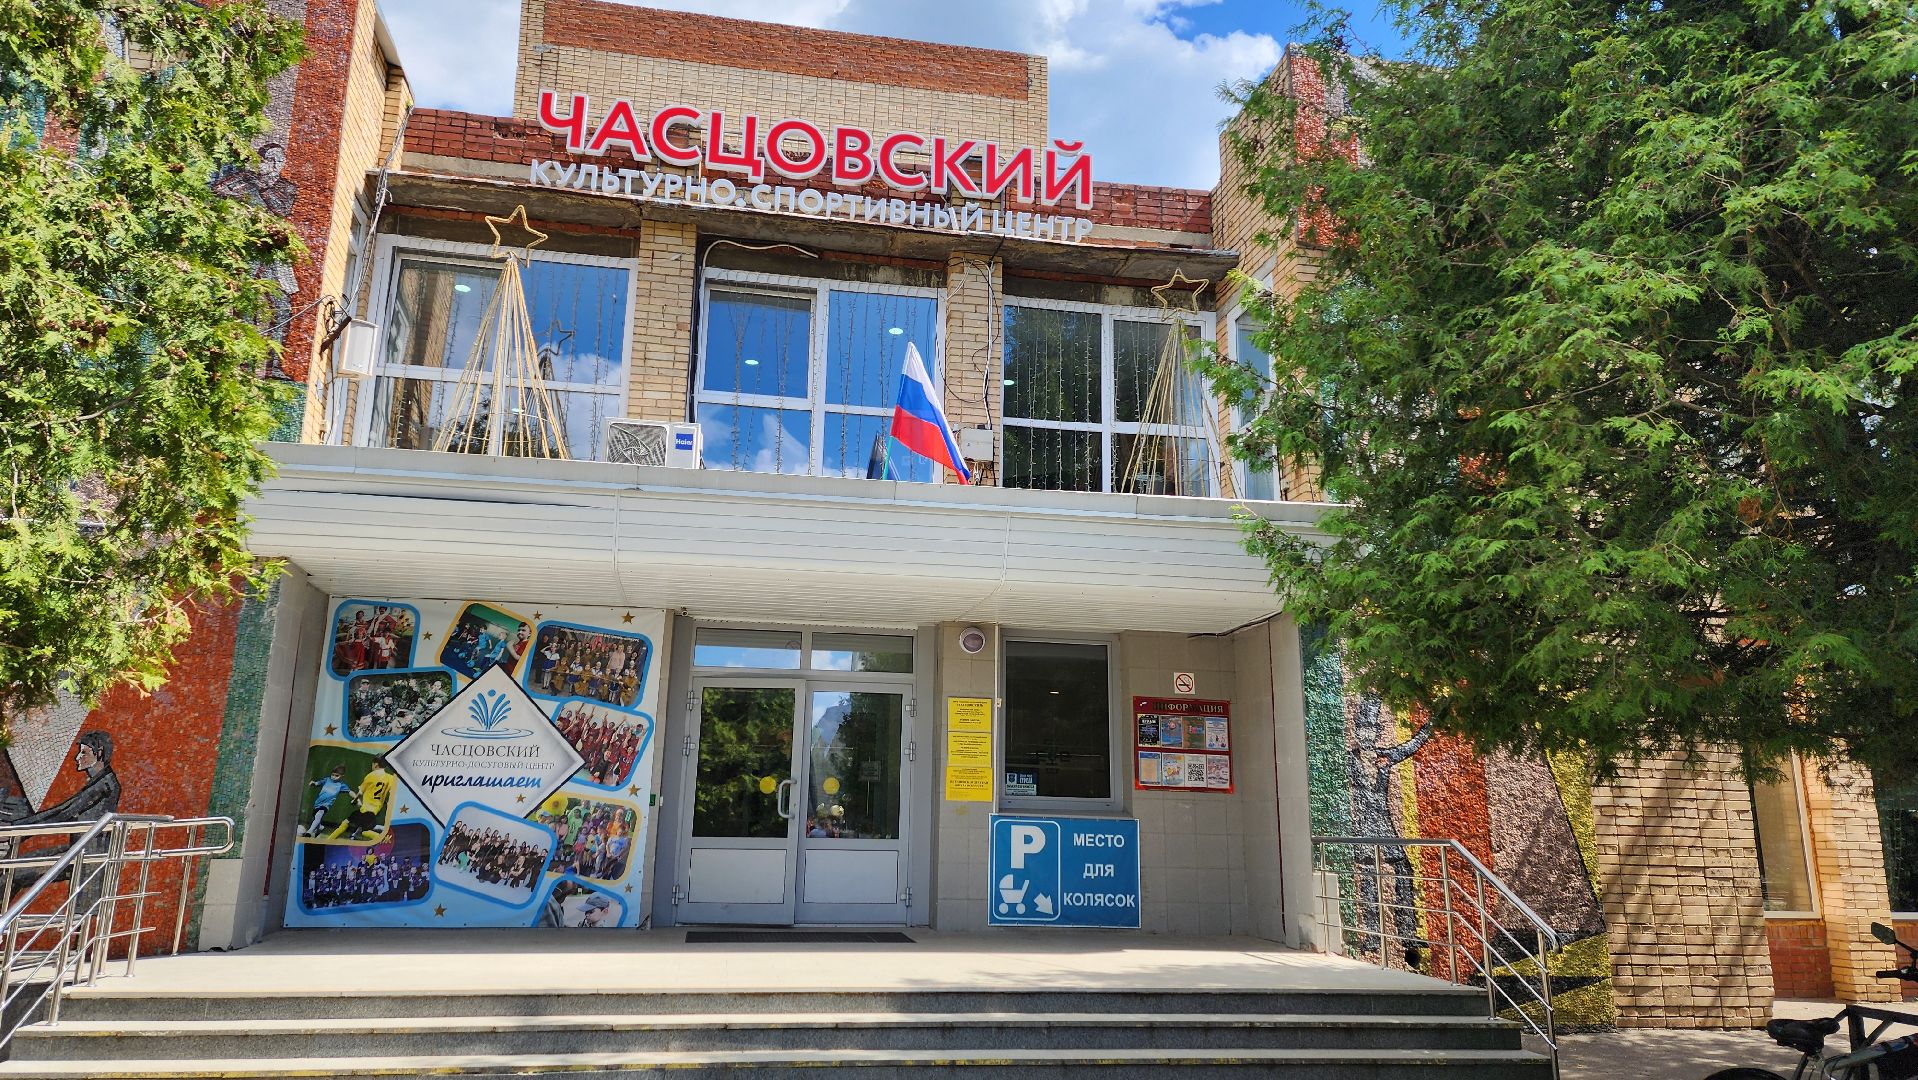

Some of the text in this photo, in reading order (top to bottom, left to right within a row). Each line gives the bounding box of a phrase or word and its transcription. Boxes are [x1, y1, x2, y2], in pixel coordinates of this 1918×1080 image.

[537, 88, 1093, 210] ЧАСЦОВСКИЙ
[992, 209, 1093, 242] ЦЕНТР
[675, 438, 693, 446] Haier
[1152, 702, 1223, 713] ИНФОРАЦИЯ
[431, 744, 540, 758] ЧАСЦОВСКИЙ
[412, 760, 555, 770] КУЛЬТУРНО-ДОСУГОВЫЙ ЦЕНТР
[373, 782, 385, 800] 2
[421, 774, 542, 793] приглашает
[1010, 825, 1046, 869] P
[1073, 833, 1125, 848] МЕСТО
[1083, 863, 1114, 879] ДЛЯ
[1063, 893, 1136, 908] КОЛЯСОК
